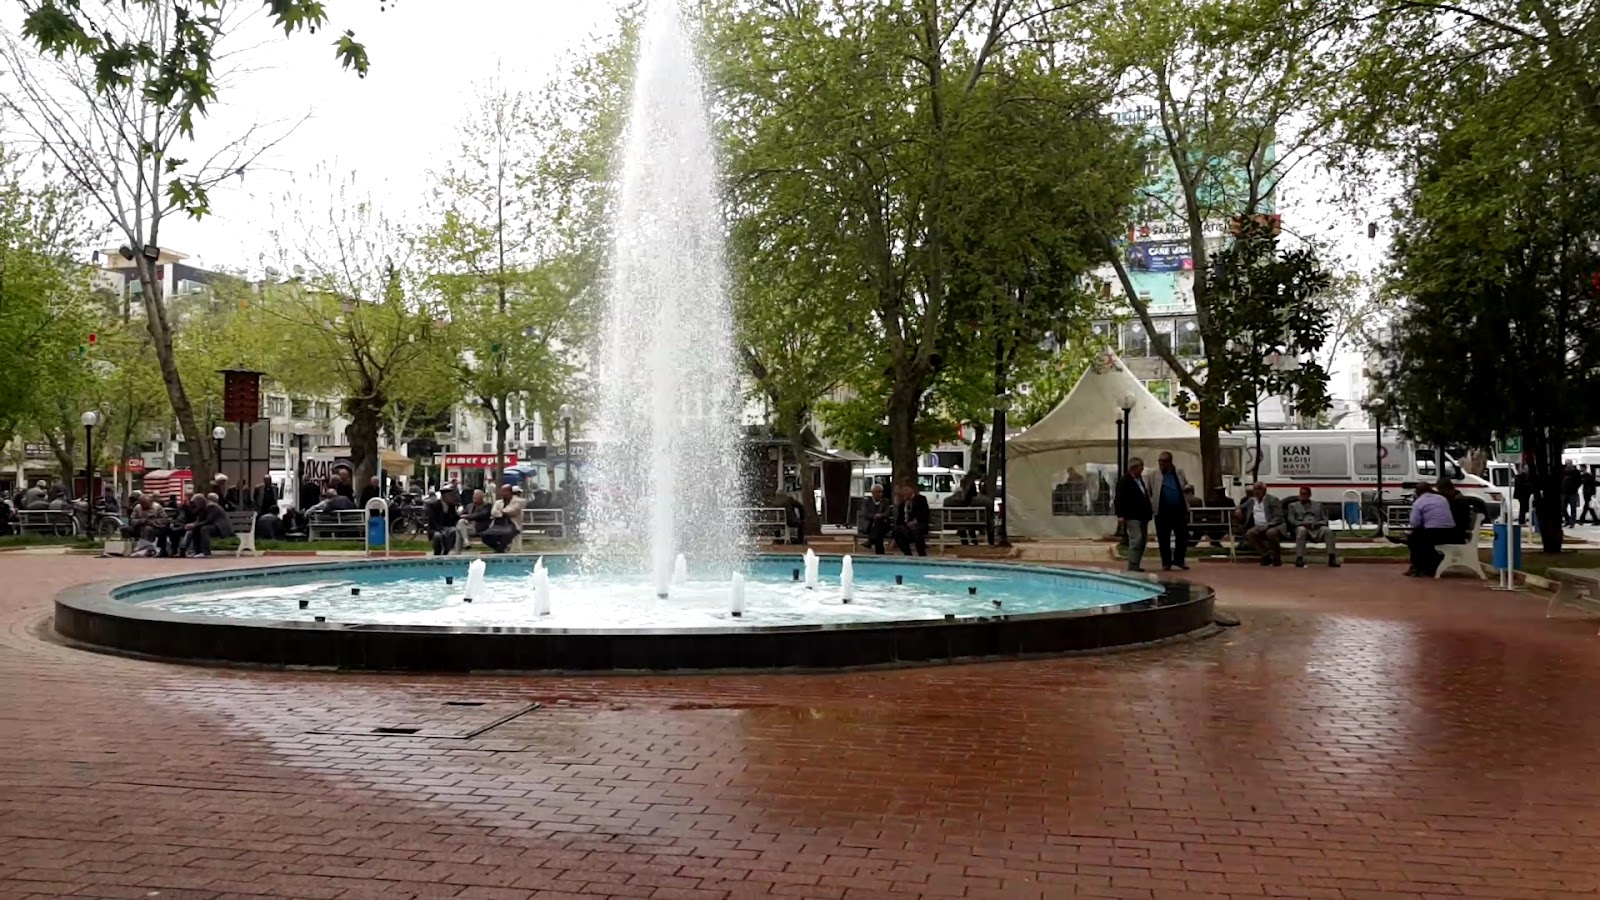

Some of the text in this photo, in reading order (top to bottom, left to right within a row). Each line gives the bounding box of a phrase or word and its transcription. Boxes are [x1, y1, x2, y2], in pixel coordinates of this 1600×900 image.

[1283, 446, 1310, 455] KAN
[480, 456, 511, 465] optk
[1283, 456, 1311, 464] BAĞIŞI
